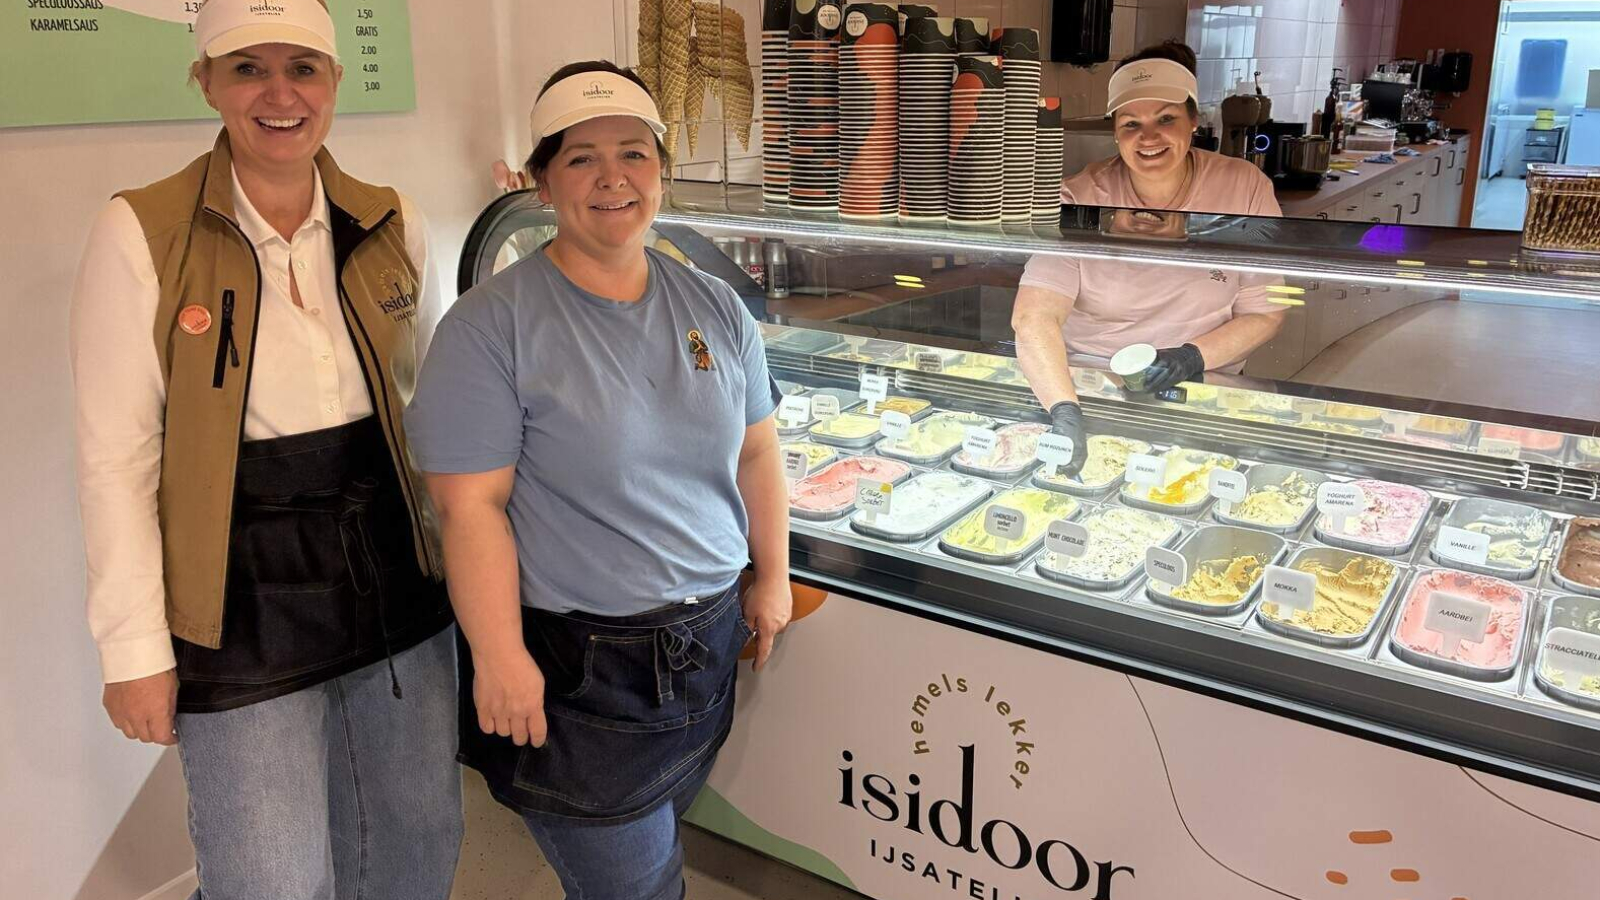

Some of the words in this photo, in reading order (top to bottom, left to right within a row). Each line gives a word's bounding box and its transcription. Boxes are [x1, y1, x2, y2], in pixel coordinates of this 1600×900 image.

[357, 9, 373, 19] 1.50
[30, 19, 99, 31] KARAMELSAUS
[356, 26, 378, 37] GRATIS
[361, 46, 377, 55] 2.00
[363, 64, 379, 73] 4.00
[364, 81, 380, 92] 3.00
[377, 282, 414, 315] isido
[1325, 499, 1354, 507] AMARENA
[1450, 541, 1477, 551] VANILLE
[1274, 582, 1298, 593] MOKKA
[1438, 609, 1473, 622] AARDBEI
[910, 673, 968, 755] hemels
[984, 685, 1034, 789] lekker
[837, 743, 1135, 900] isidoor
